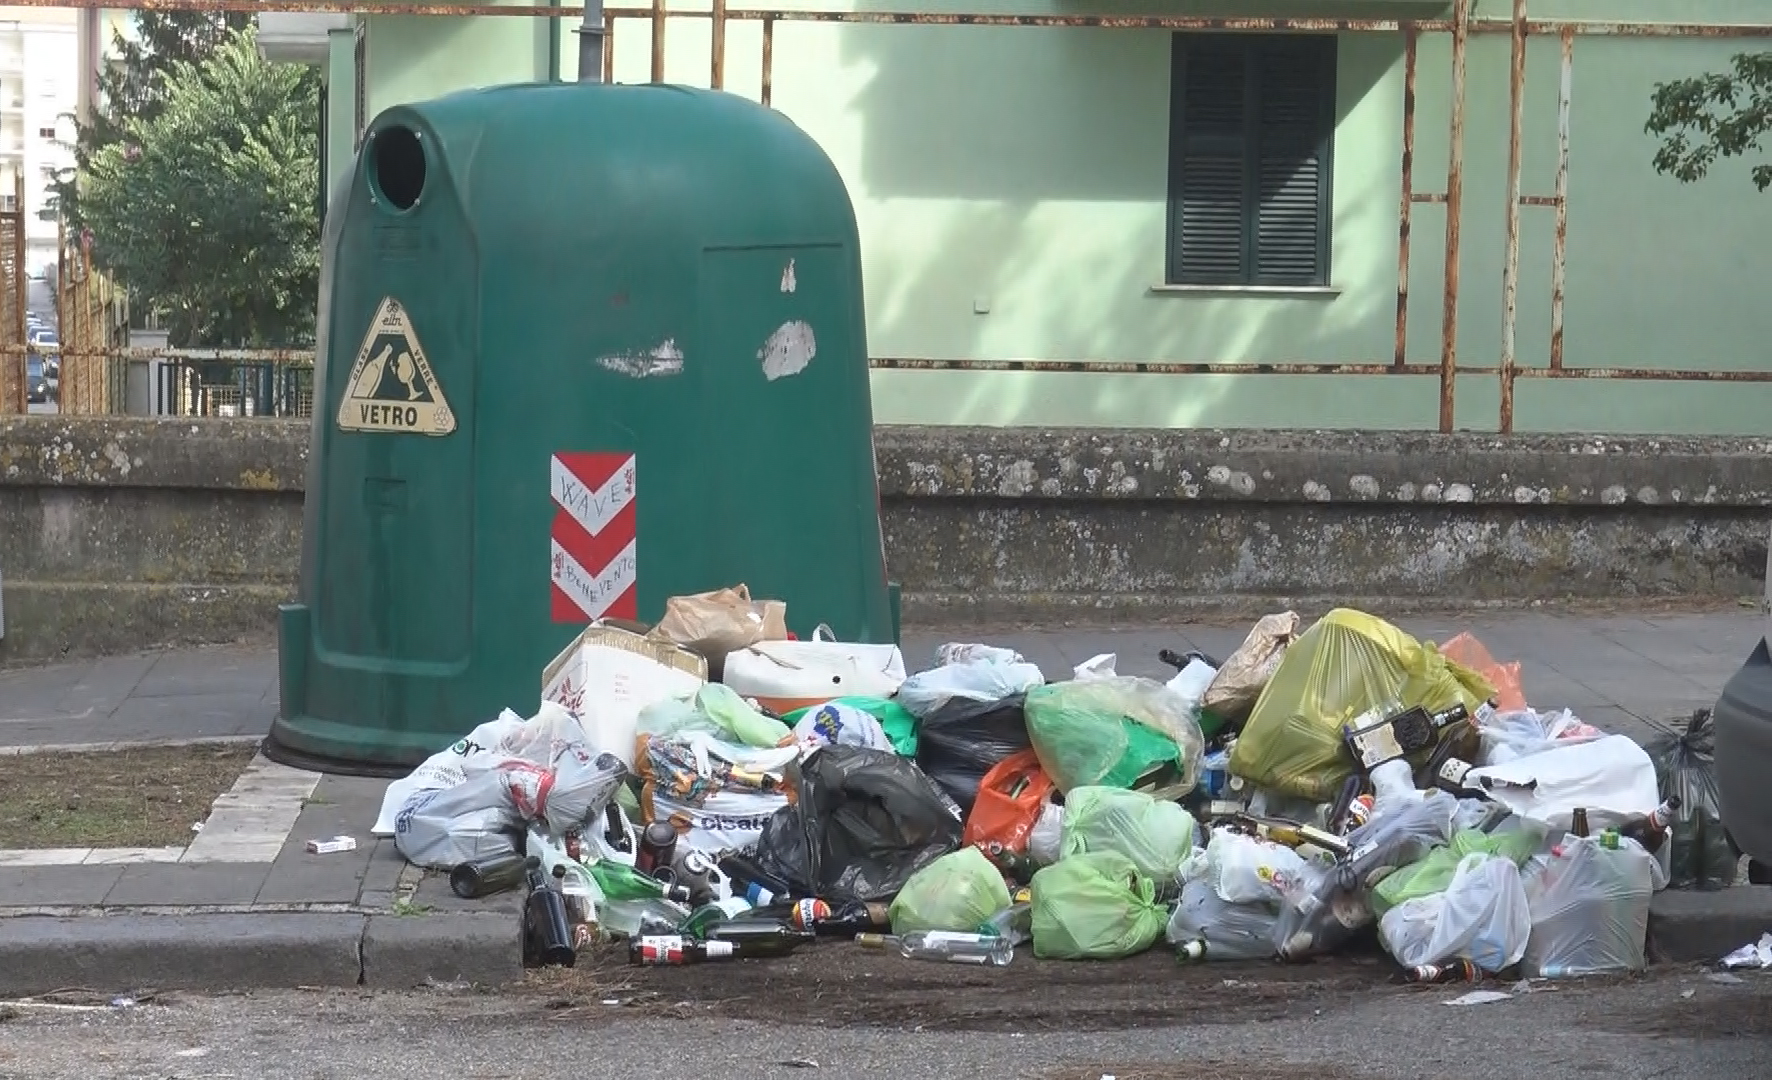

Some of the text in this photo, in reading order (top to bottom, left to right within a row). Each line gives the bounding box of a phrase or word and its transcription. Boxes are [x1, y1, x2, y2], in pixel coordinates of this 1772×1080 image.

[352, 347, 370, 381] GLASS
[414, 349, 433, 384] VERRE
[360, 404, 418, 426] VETRO
[561, 475, 622, 518] WAVE
